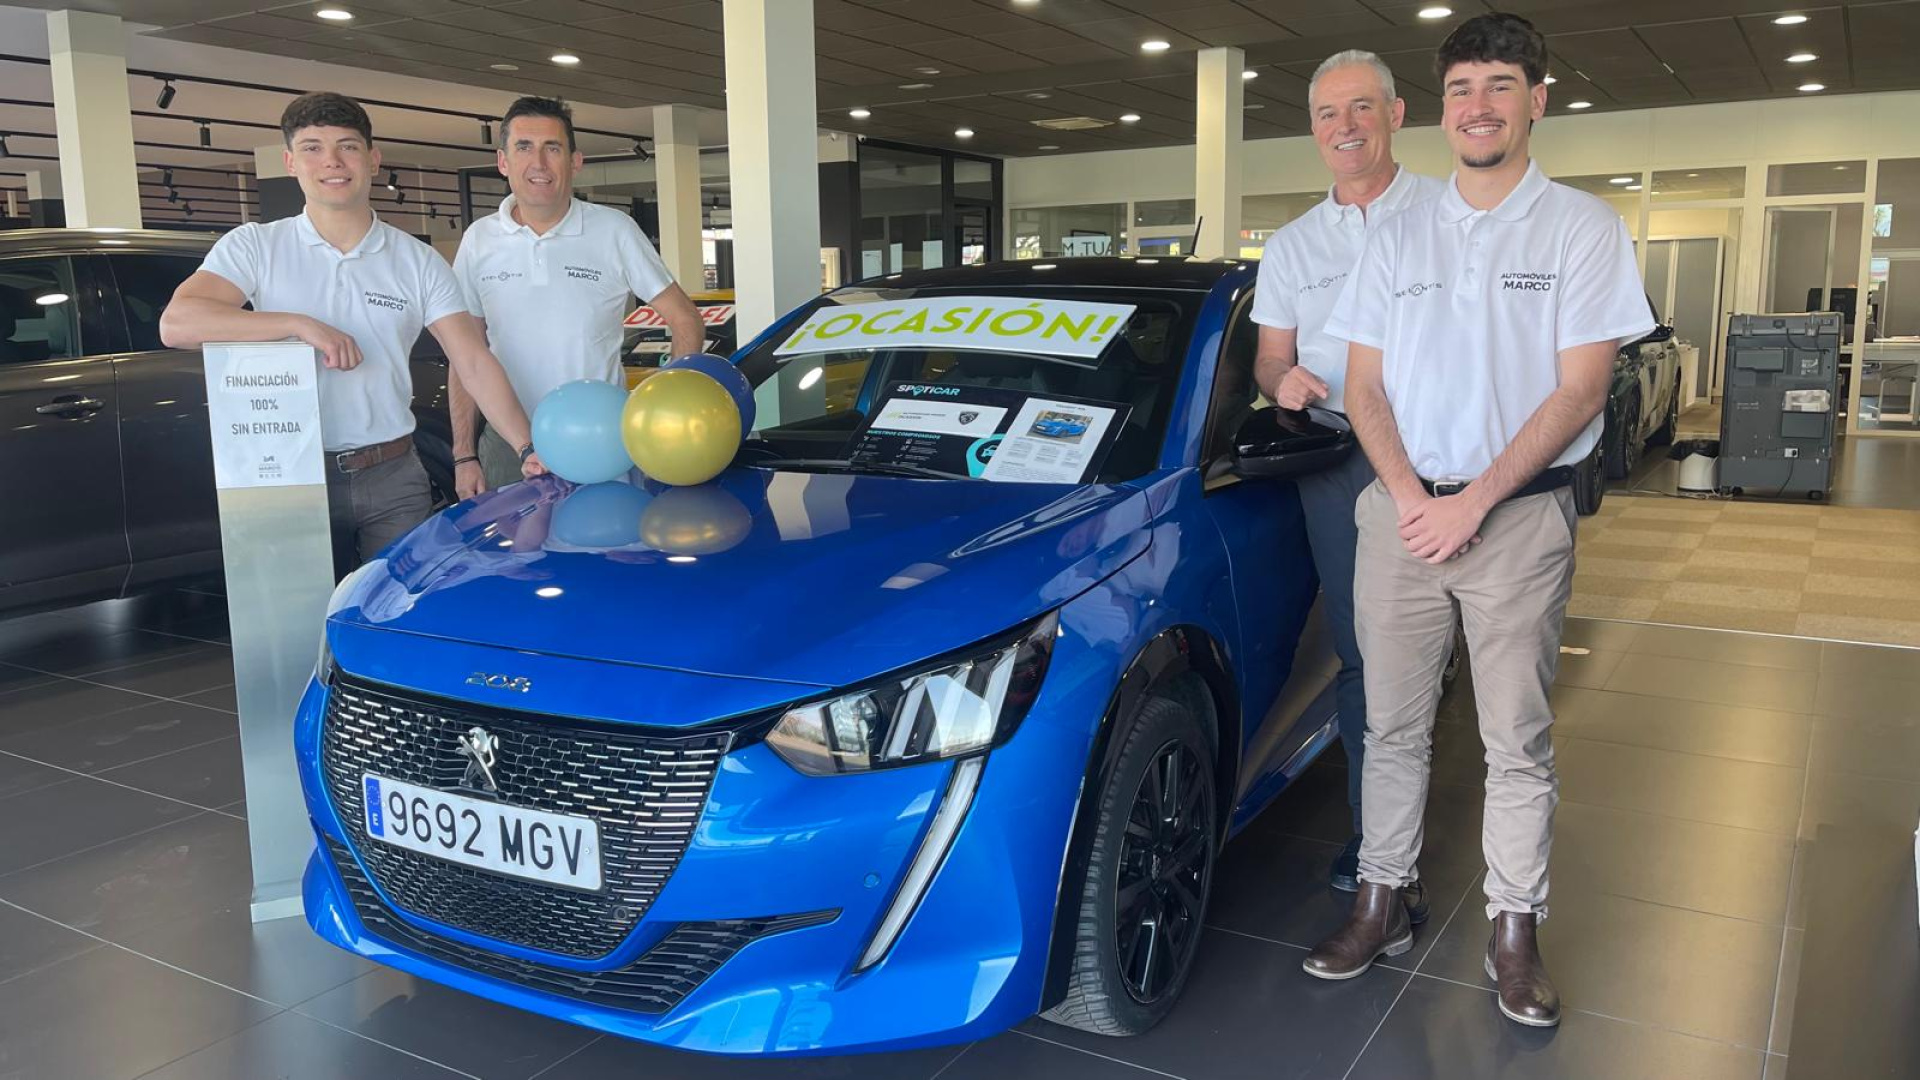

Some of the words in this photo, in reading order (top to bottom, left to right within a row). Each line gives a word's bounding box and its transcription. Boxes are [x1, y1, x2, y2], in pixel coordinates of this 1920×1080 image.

[1503, 280, 1551, 291] MARCO
[367, 298, 404, 311] MARCO
[785, 303, 1119, 349] ¡OCASIÓN!
[225, 372, 299, 387] FINANCIACIÓN
[250, 399, 279, 410] 100%
[231, 423, 250, 435] SIN
[253, 422, 301, 434] ENTRADA
[465, 671, 531, 693] 208
[372, 814, 379, 826] E
[388, 791, 484, 857] 9692
[499, 815, 582, 876] MGV
